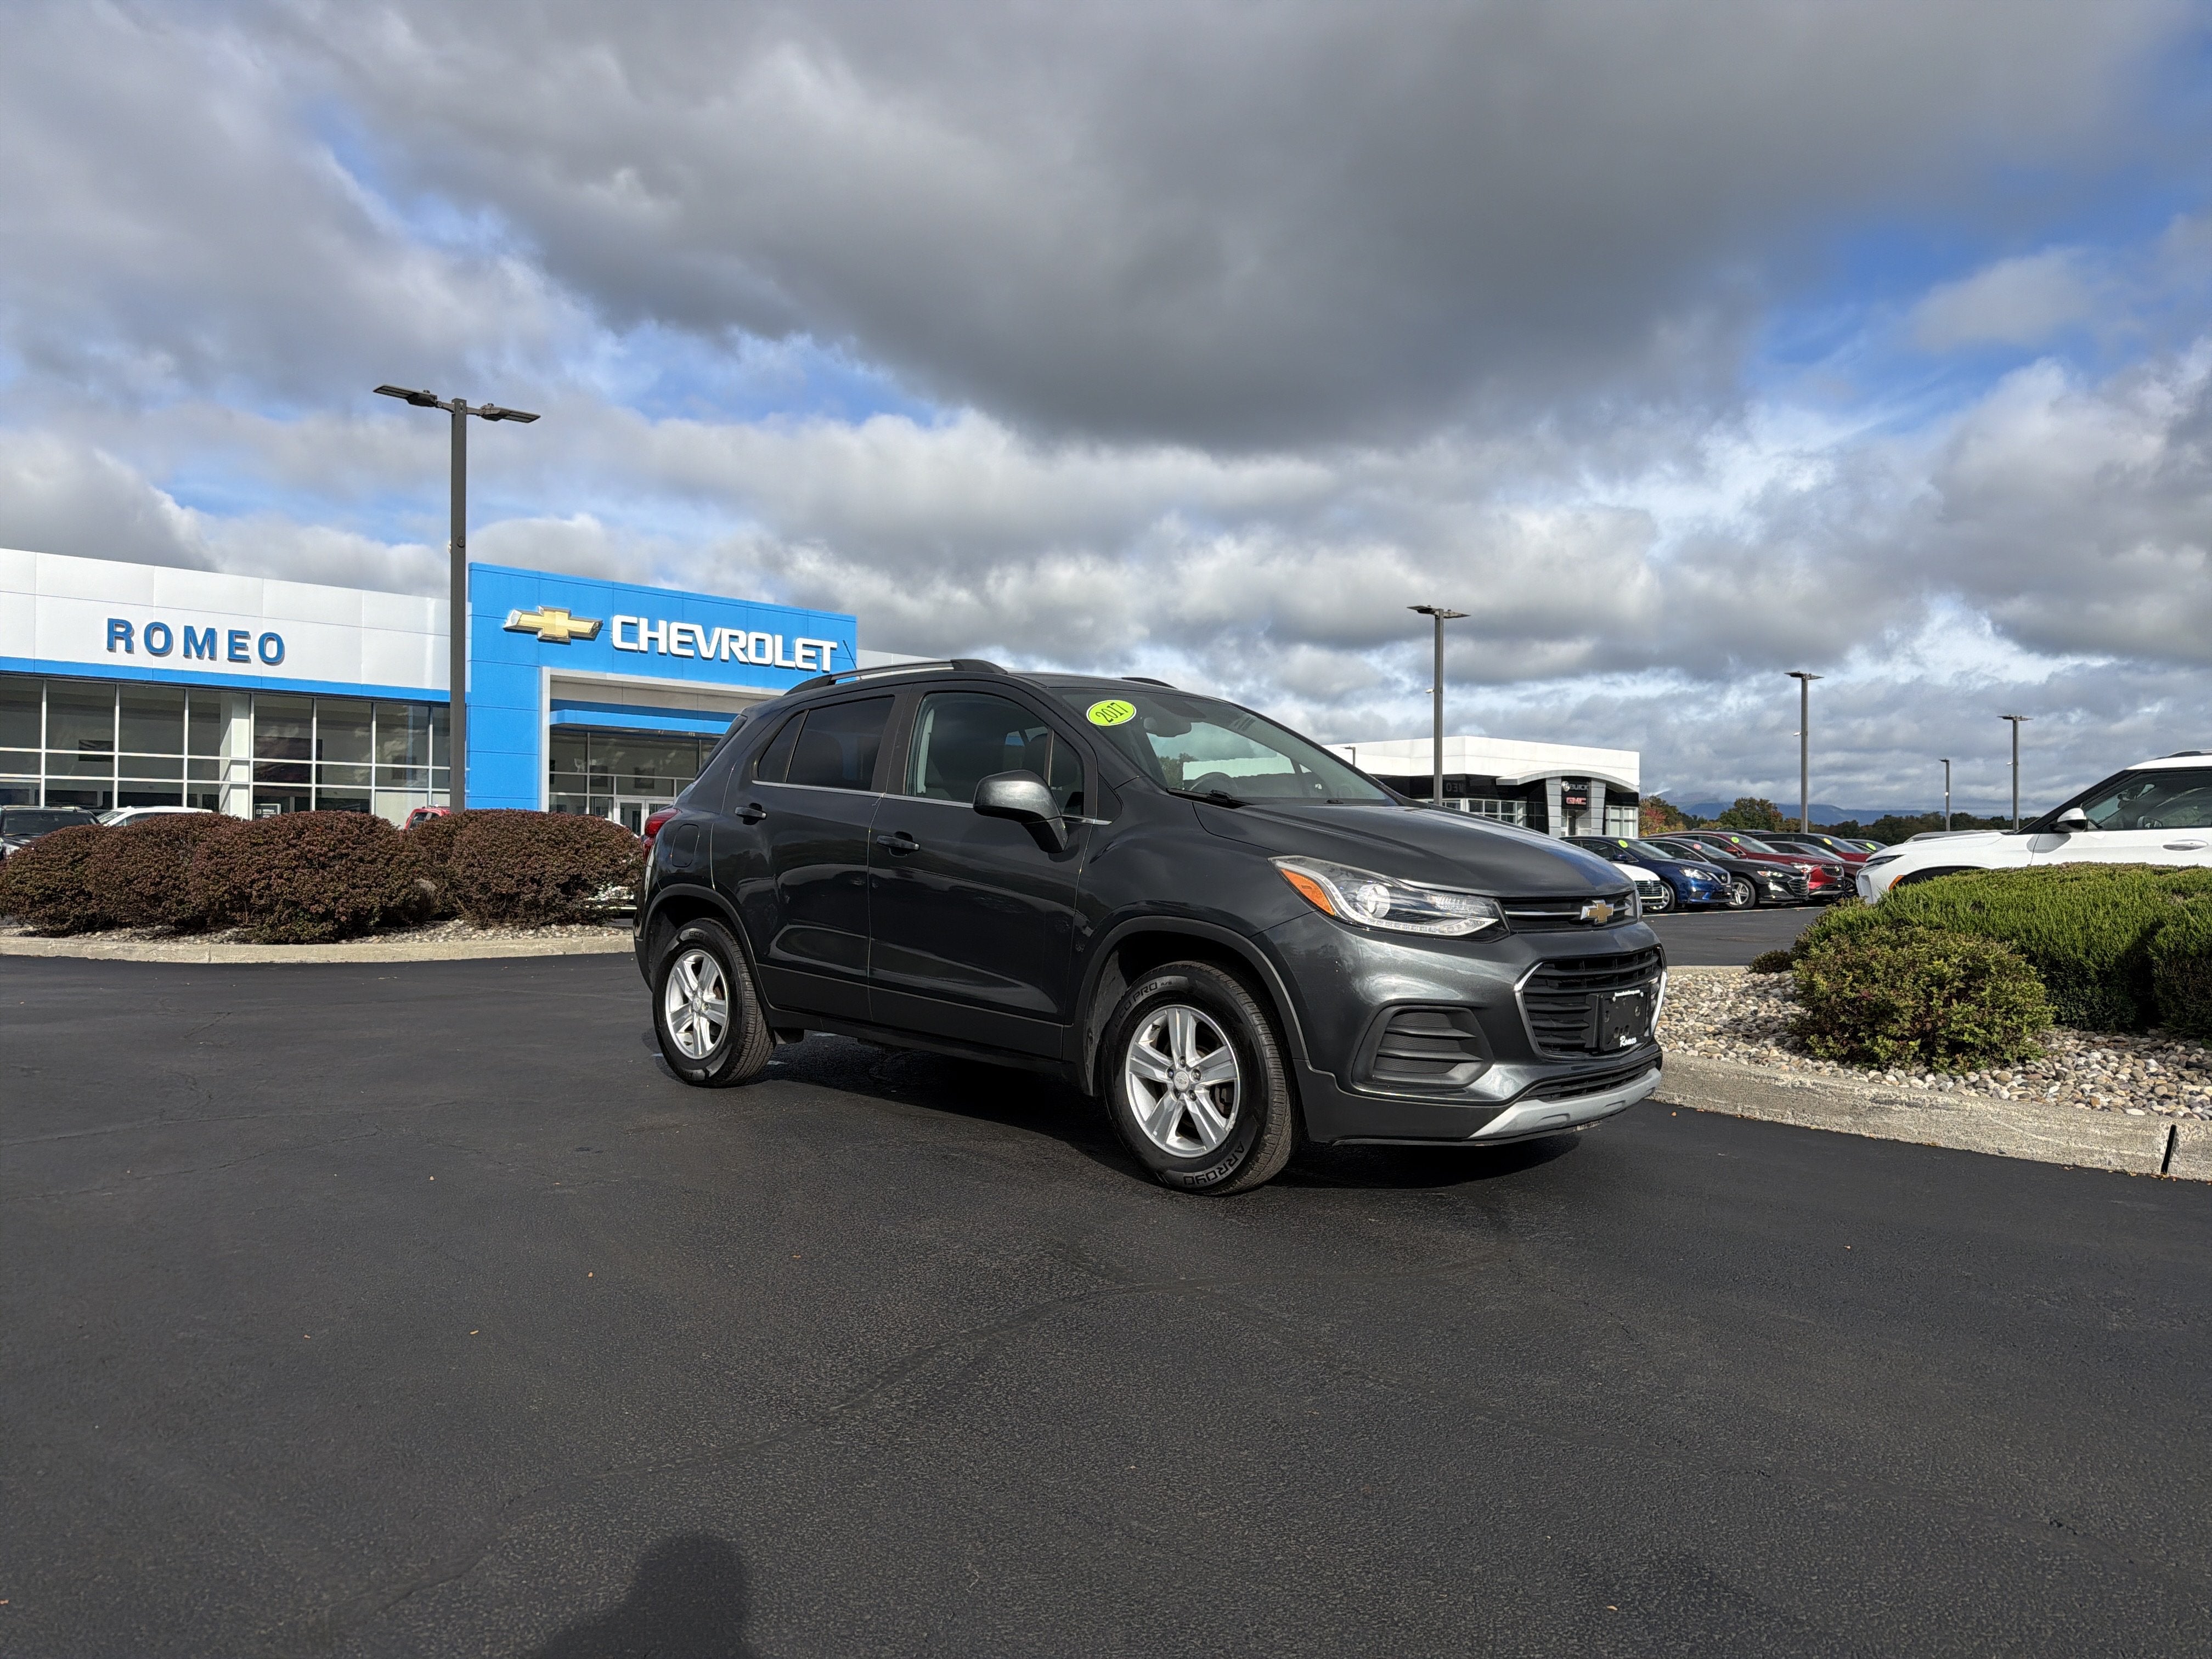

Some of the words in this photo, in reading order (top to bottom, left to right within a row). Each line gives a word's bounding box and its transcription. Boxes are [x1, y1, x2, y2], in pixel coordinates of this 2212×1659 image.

[106, 618, 285, 665] ROMEO
[612, 614, 838, 673] CHEVROLET
[1095, 702, 1128, 723] 2017
[1133, 981, 1158, 1002] PRO
[1620, 1035, 1637, 1047] Romeo
[1183, 1141, 1245, 1185] ARROYO
